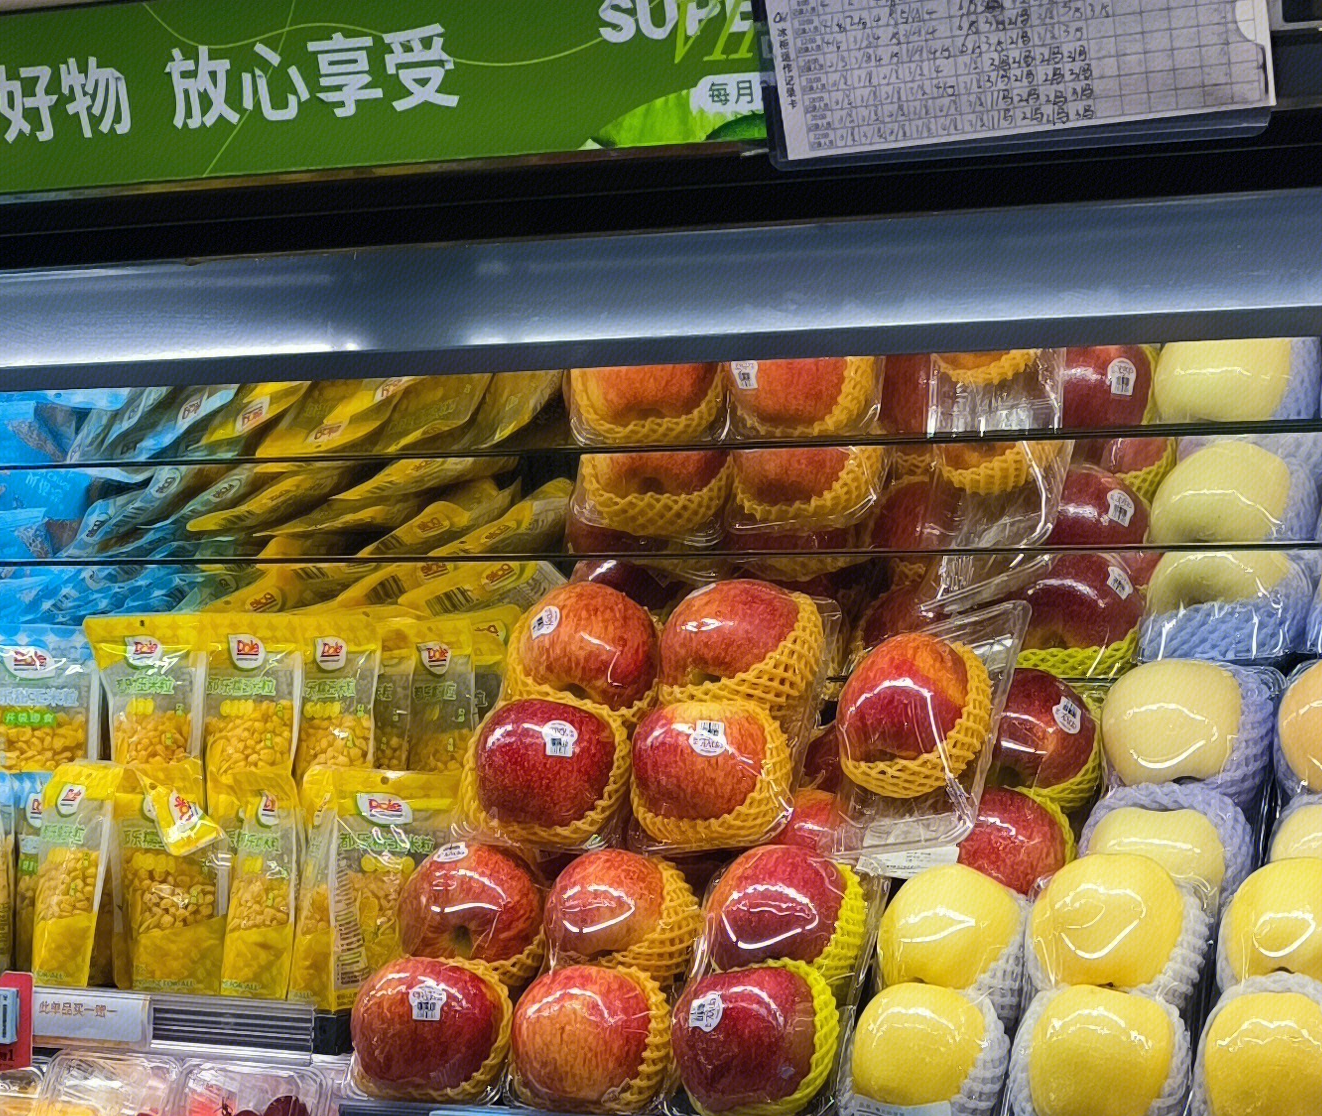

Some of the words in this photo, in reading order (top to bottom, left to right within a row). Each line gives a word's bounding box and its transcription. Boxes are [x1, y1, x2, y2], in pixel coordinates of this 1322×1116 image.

[598, 0, 759, 44] SUPE
[165, 22, 461, 131] 放心享受
[133, 640, 158, 655] Dole
[236, 639, 260, 654] Dole
[321, 641, 344, 656] Dole
[426, 646, 449, 660] Dole
[367, 798, 404, 814] Dole
